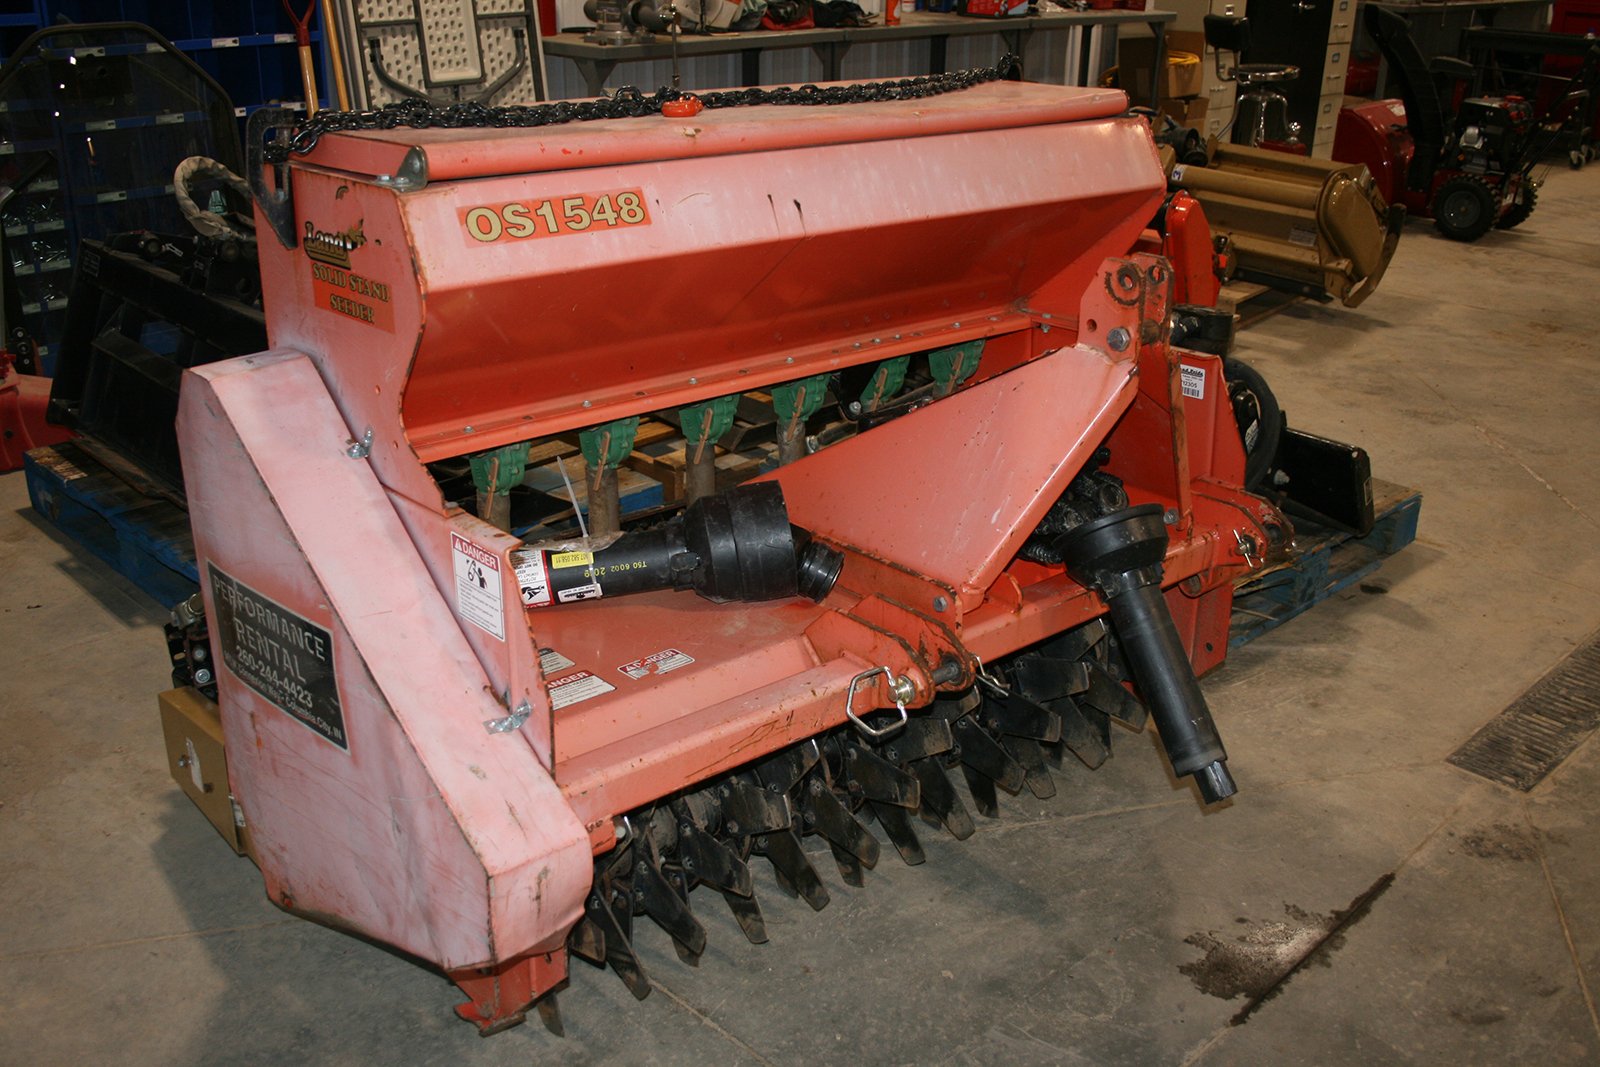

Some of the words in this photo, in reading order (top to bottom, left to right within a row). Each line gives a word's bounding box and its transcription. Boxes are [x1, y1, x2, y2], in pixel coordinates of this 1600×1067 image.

[465, 192, 645, 243] OS1548
[313, 263, 347, 289] SOLID
[348, 275, 390, 303] STAND
[329, 293, 375, 324] SEEDER
[462, 540, 496, 570] DANGER
[584, 566, 606, 579] 209
[610, 563, 630, 573] 6002
[214, 577, 325, 661] PERFORMANCE
[234, 617, 306, 683] RENTAL
[236, 645, 314, 708] 260-244-4423
